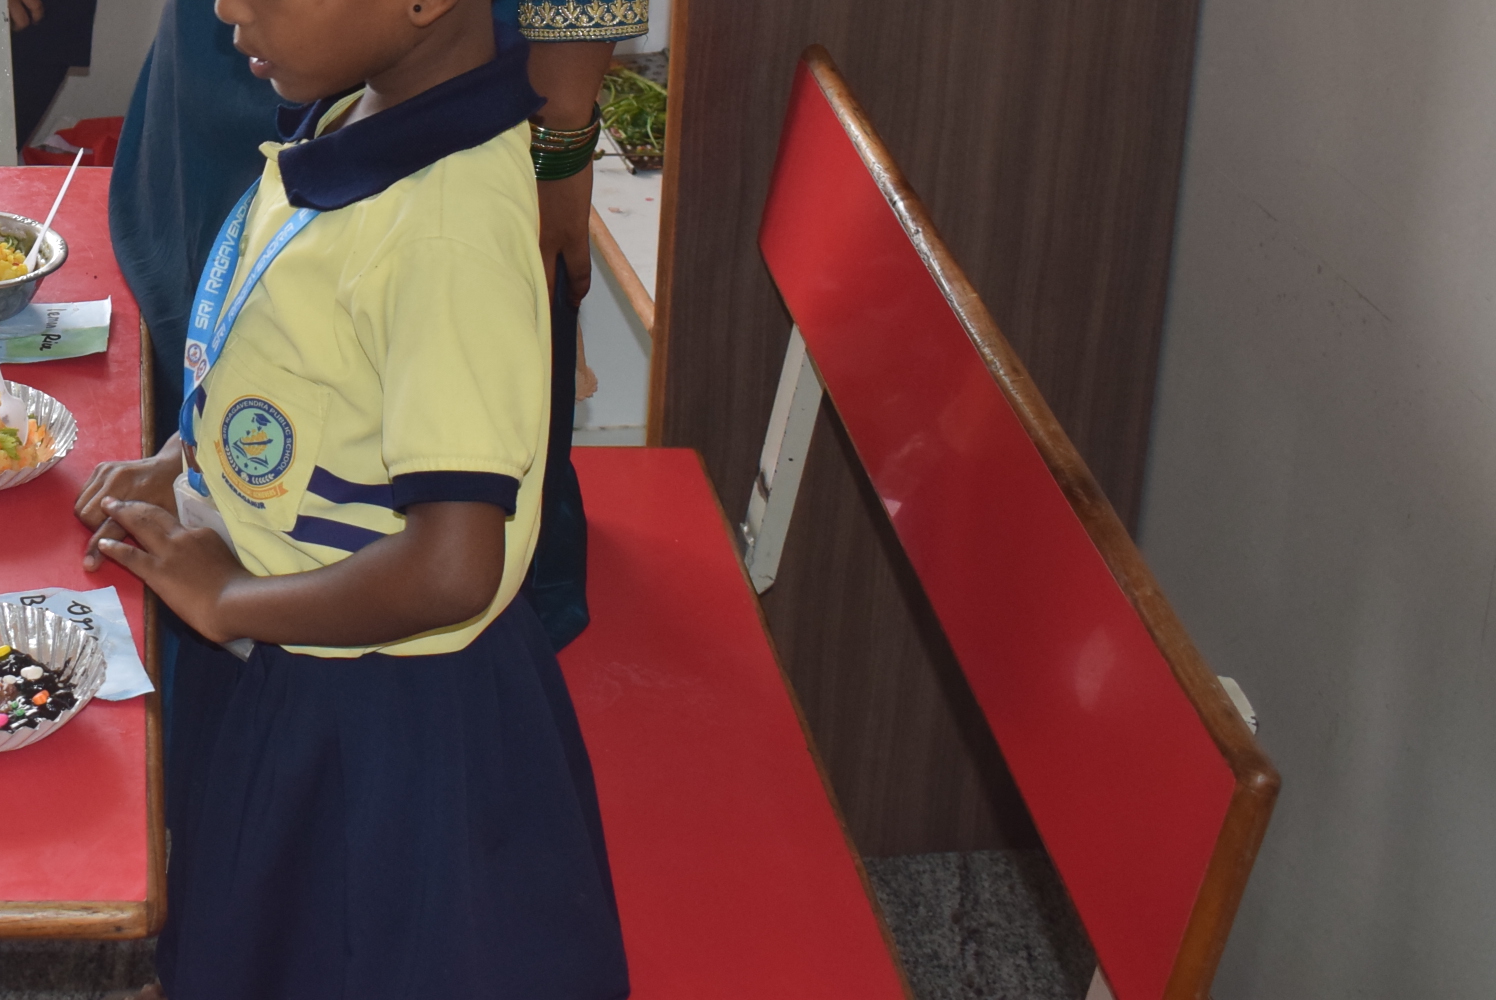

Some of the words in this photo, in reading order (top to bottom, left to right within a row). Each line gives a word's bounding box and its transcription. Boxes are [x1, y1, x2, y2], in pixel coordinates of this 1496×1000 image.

[204, 191, 255, 295] RAGAVENDR
[194, 299, 215, 330] SRI
[211, 322, 226, 353] SRI
[225, 399, 269, 424] RAGAVENDRA
[269, 407, 292, 436] PUBLIC
[276, 437, 292, 472] SCHOOL
